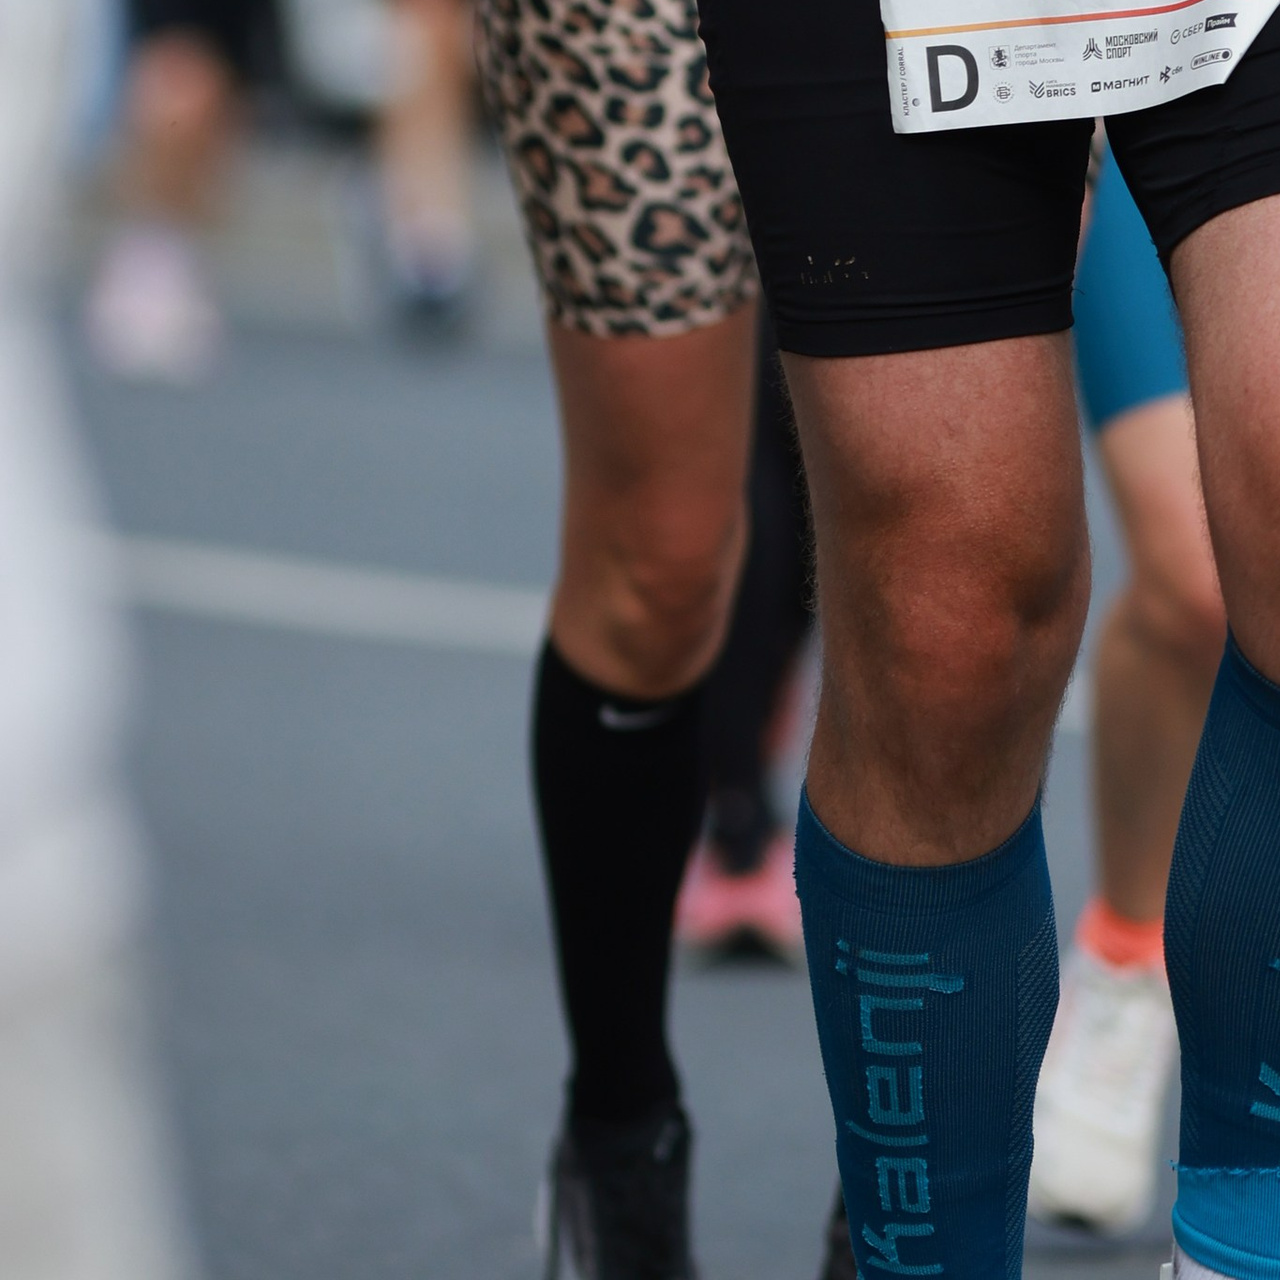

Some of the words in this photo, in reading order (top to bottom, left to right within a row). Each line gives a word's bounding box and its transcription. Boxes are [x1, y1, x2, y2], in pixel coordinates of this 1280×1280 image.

[1105, 29, 1159, 47] МОСКОВСКИЙ
[1182, 22, 1204, 39] СБЕР
[1106, 46, 1132, 60] СПОРТ
[1193, 52, 1221, 67] WINLINE
[926, 44, 980, 113] D
[901, 82, 910, 117] КЛАСТЕР
[1046, 87, 1076, 98] BRICS
